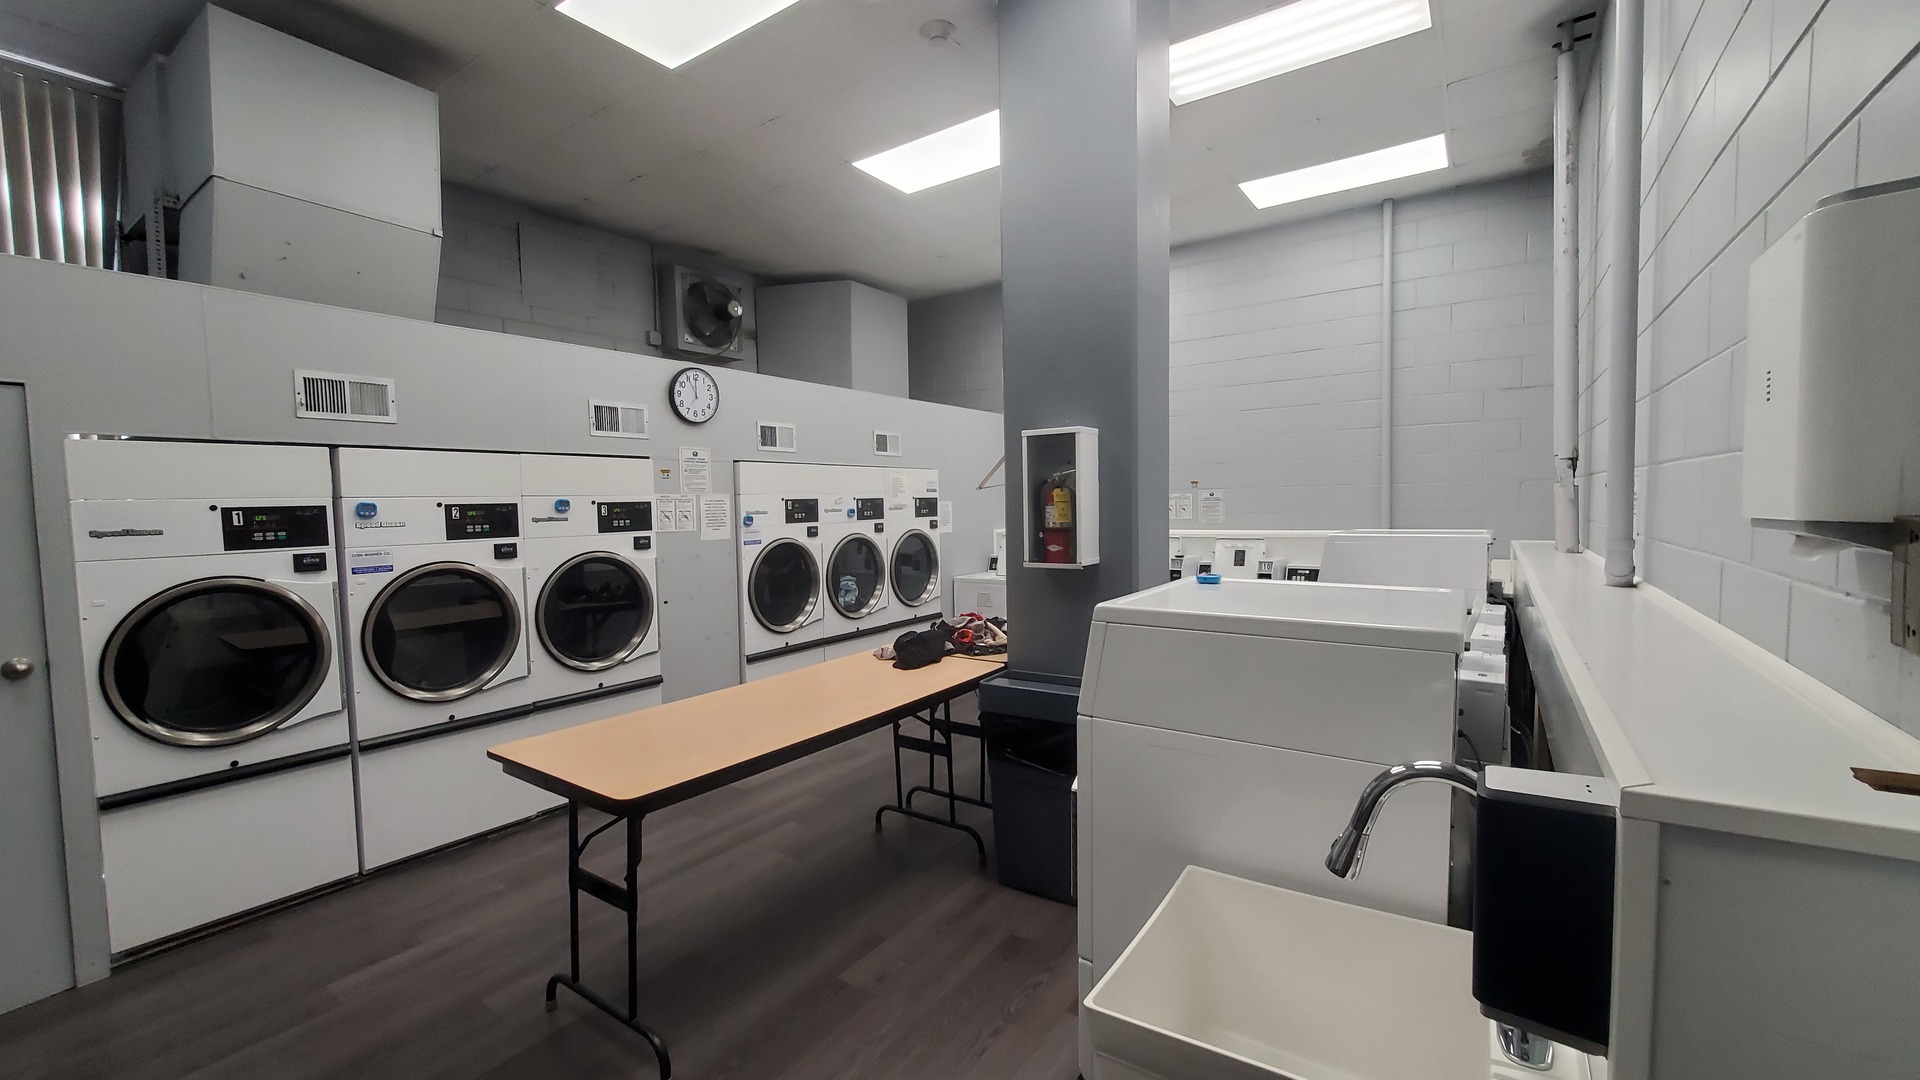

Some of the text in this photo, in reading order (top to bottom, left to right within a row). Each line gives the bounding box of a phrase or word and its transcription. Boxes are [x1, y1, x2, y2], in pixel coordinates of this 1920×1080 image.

[693, 373, 699, 381] 12
[453, 507, 459, 519] 2
[602, 507, 607, 515] 3
[235, 512, 241, 524] 1
